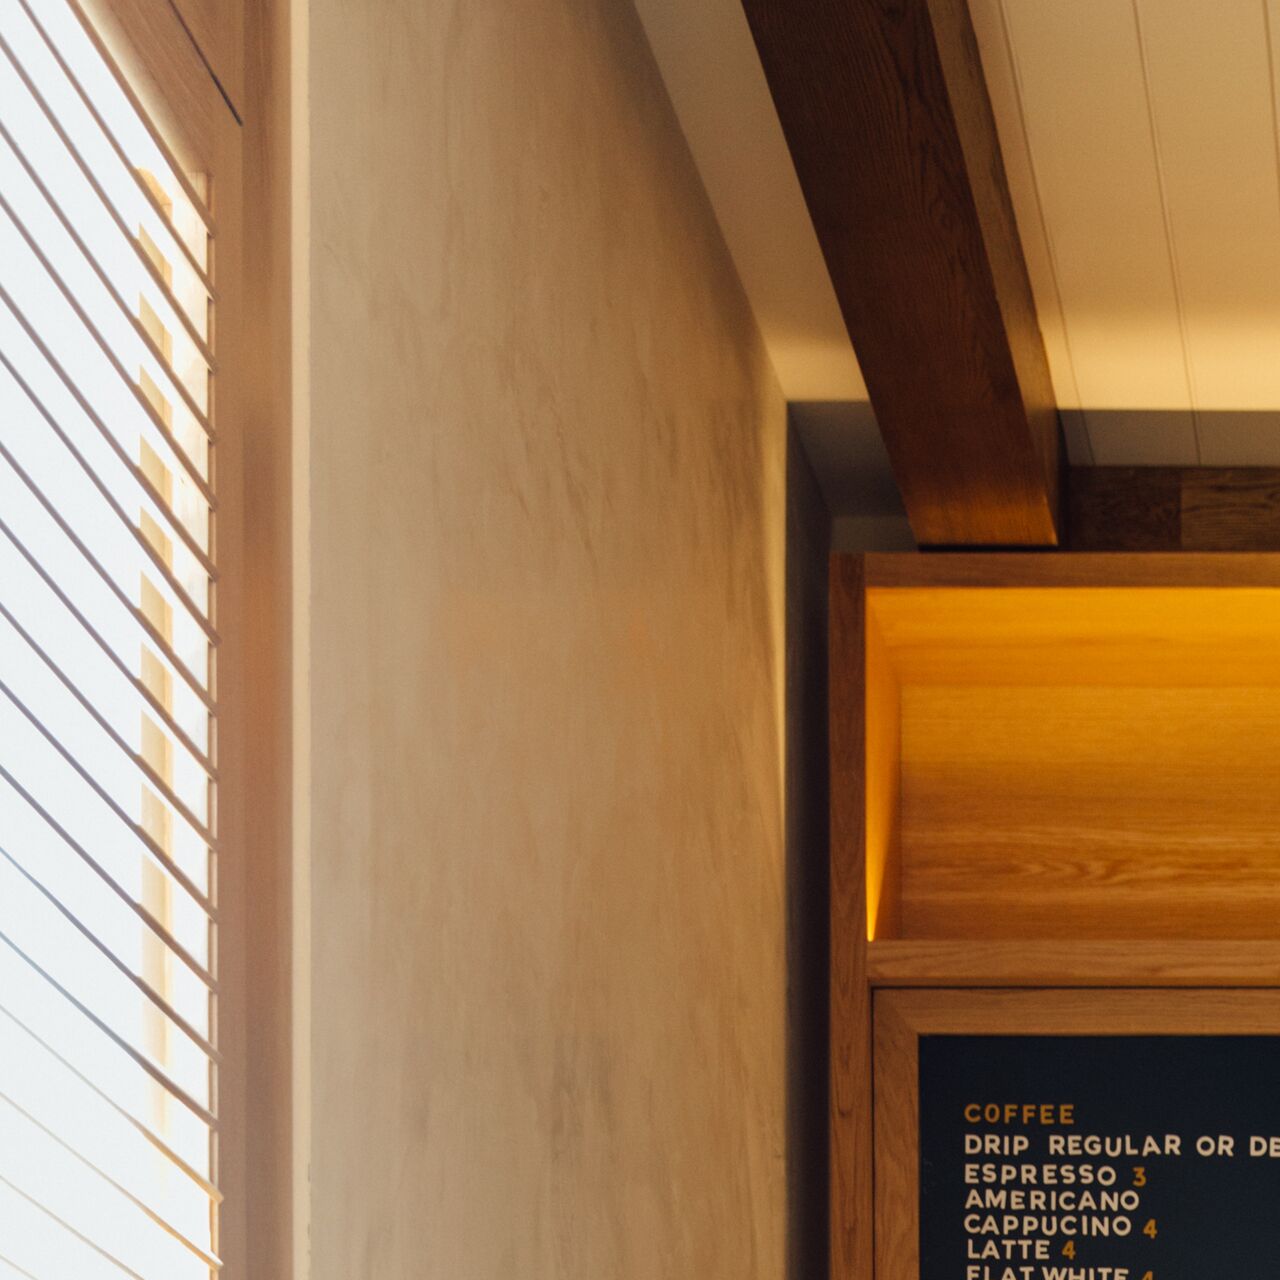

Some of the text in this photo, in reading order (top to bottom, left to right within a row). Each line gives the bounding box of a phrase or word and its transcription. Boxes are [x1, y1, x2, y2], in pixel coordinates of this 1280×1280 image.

[965, 1104, 1073, 1124] COFFEE
[965, 1135, 1028, 1155] DRIP
[1050, 1135, 1180, 1157] REGULAR
[1197, 1135, 1234, 1156] OR
[965, 1164, 1146, 1186] ESPRESSO 3
[965, 1189, 1139, 1211] AMERICANO
[964, 1214, 1157, 1238] CAPPUCINO 4
[968, 1239, 1075, 1259] LATTE 4
